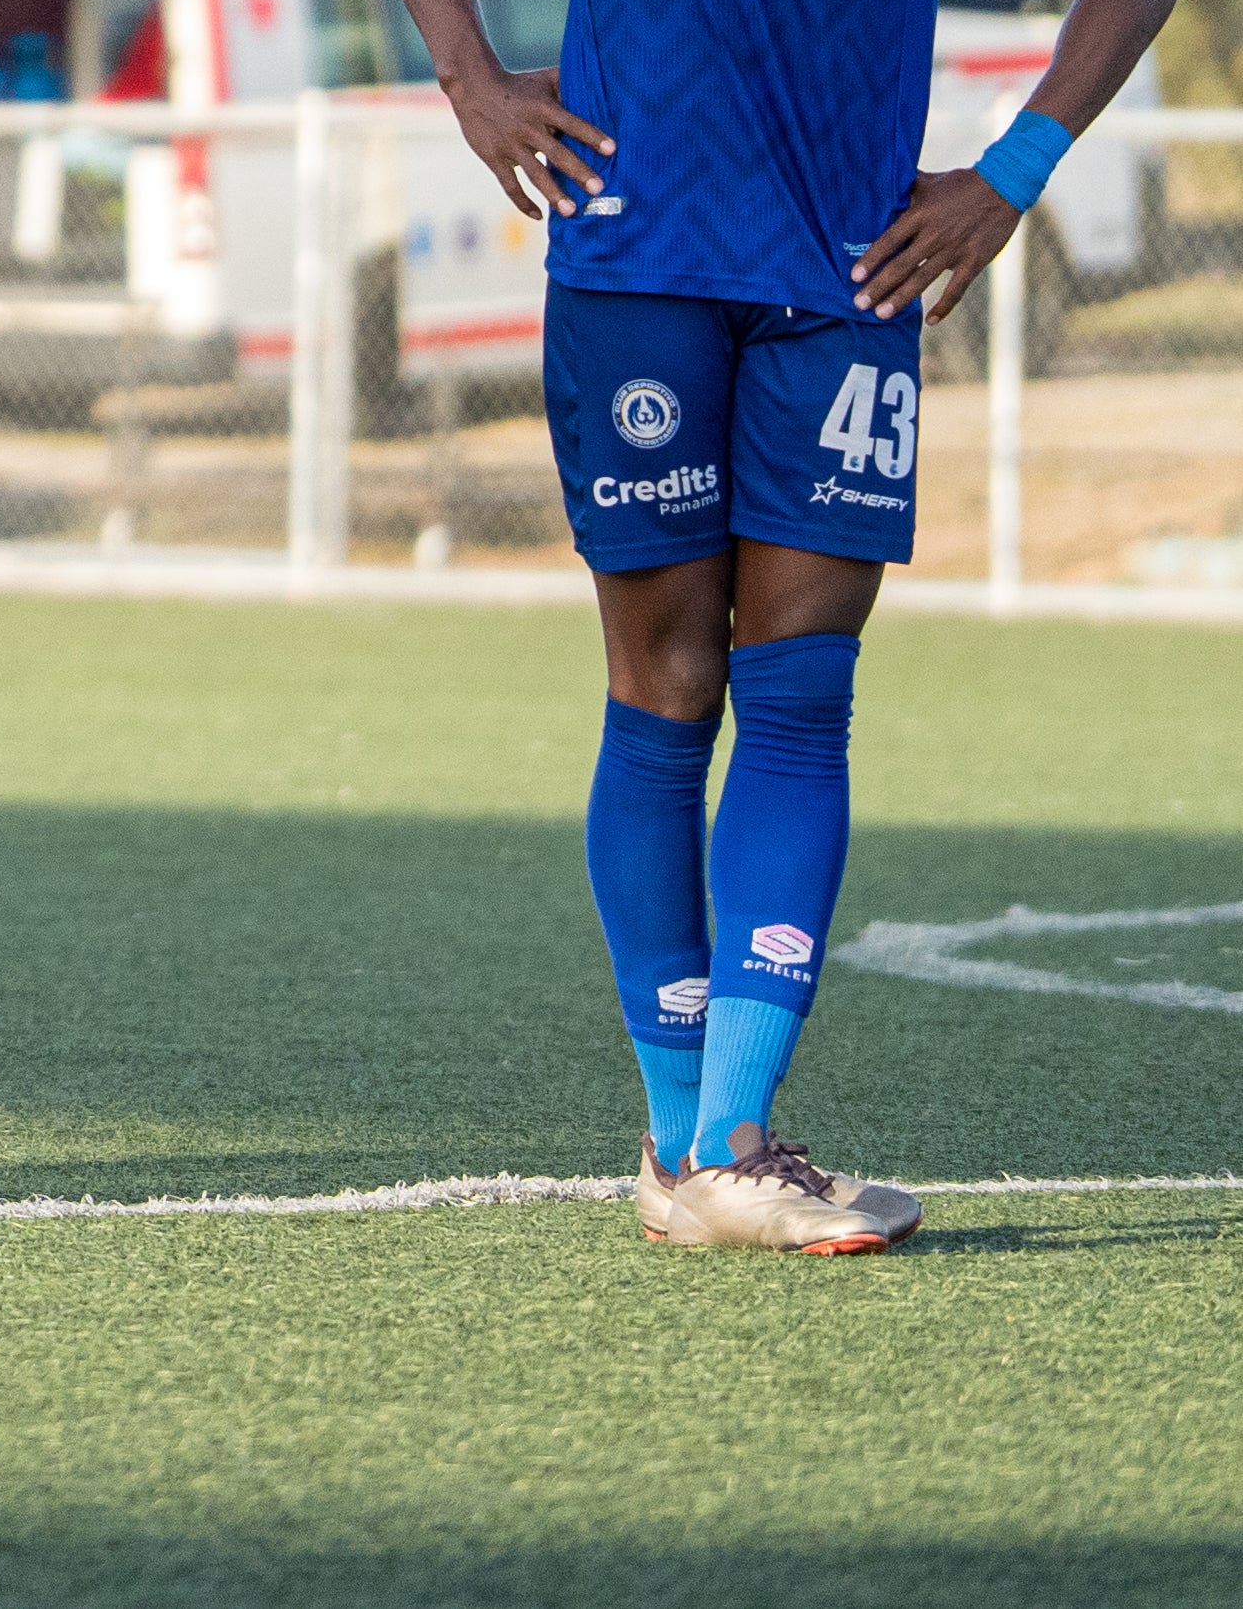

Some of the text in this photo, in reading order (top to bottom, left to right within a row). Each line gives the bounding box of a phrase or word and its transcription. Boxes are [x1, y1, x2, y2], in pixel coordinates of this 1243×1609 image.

[818, 363, 917, 480] 43
[592, 464, 718, 508] Credits
[659, 489, 721, 516] Panamá
[840, 489, 910, 513] SHEFFY
[741, 958, 812, 984] SPIELER
[657, 1010, 707, 1025] SPIEL
